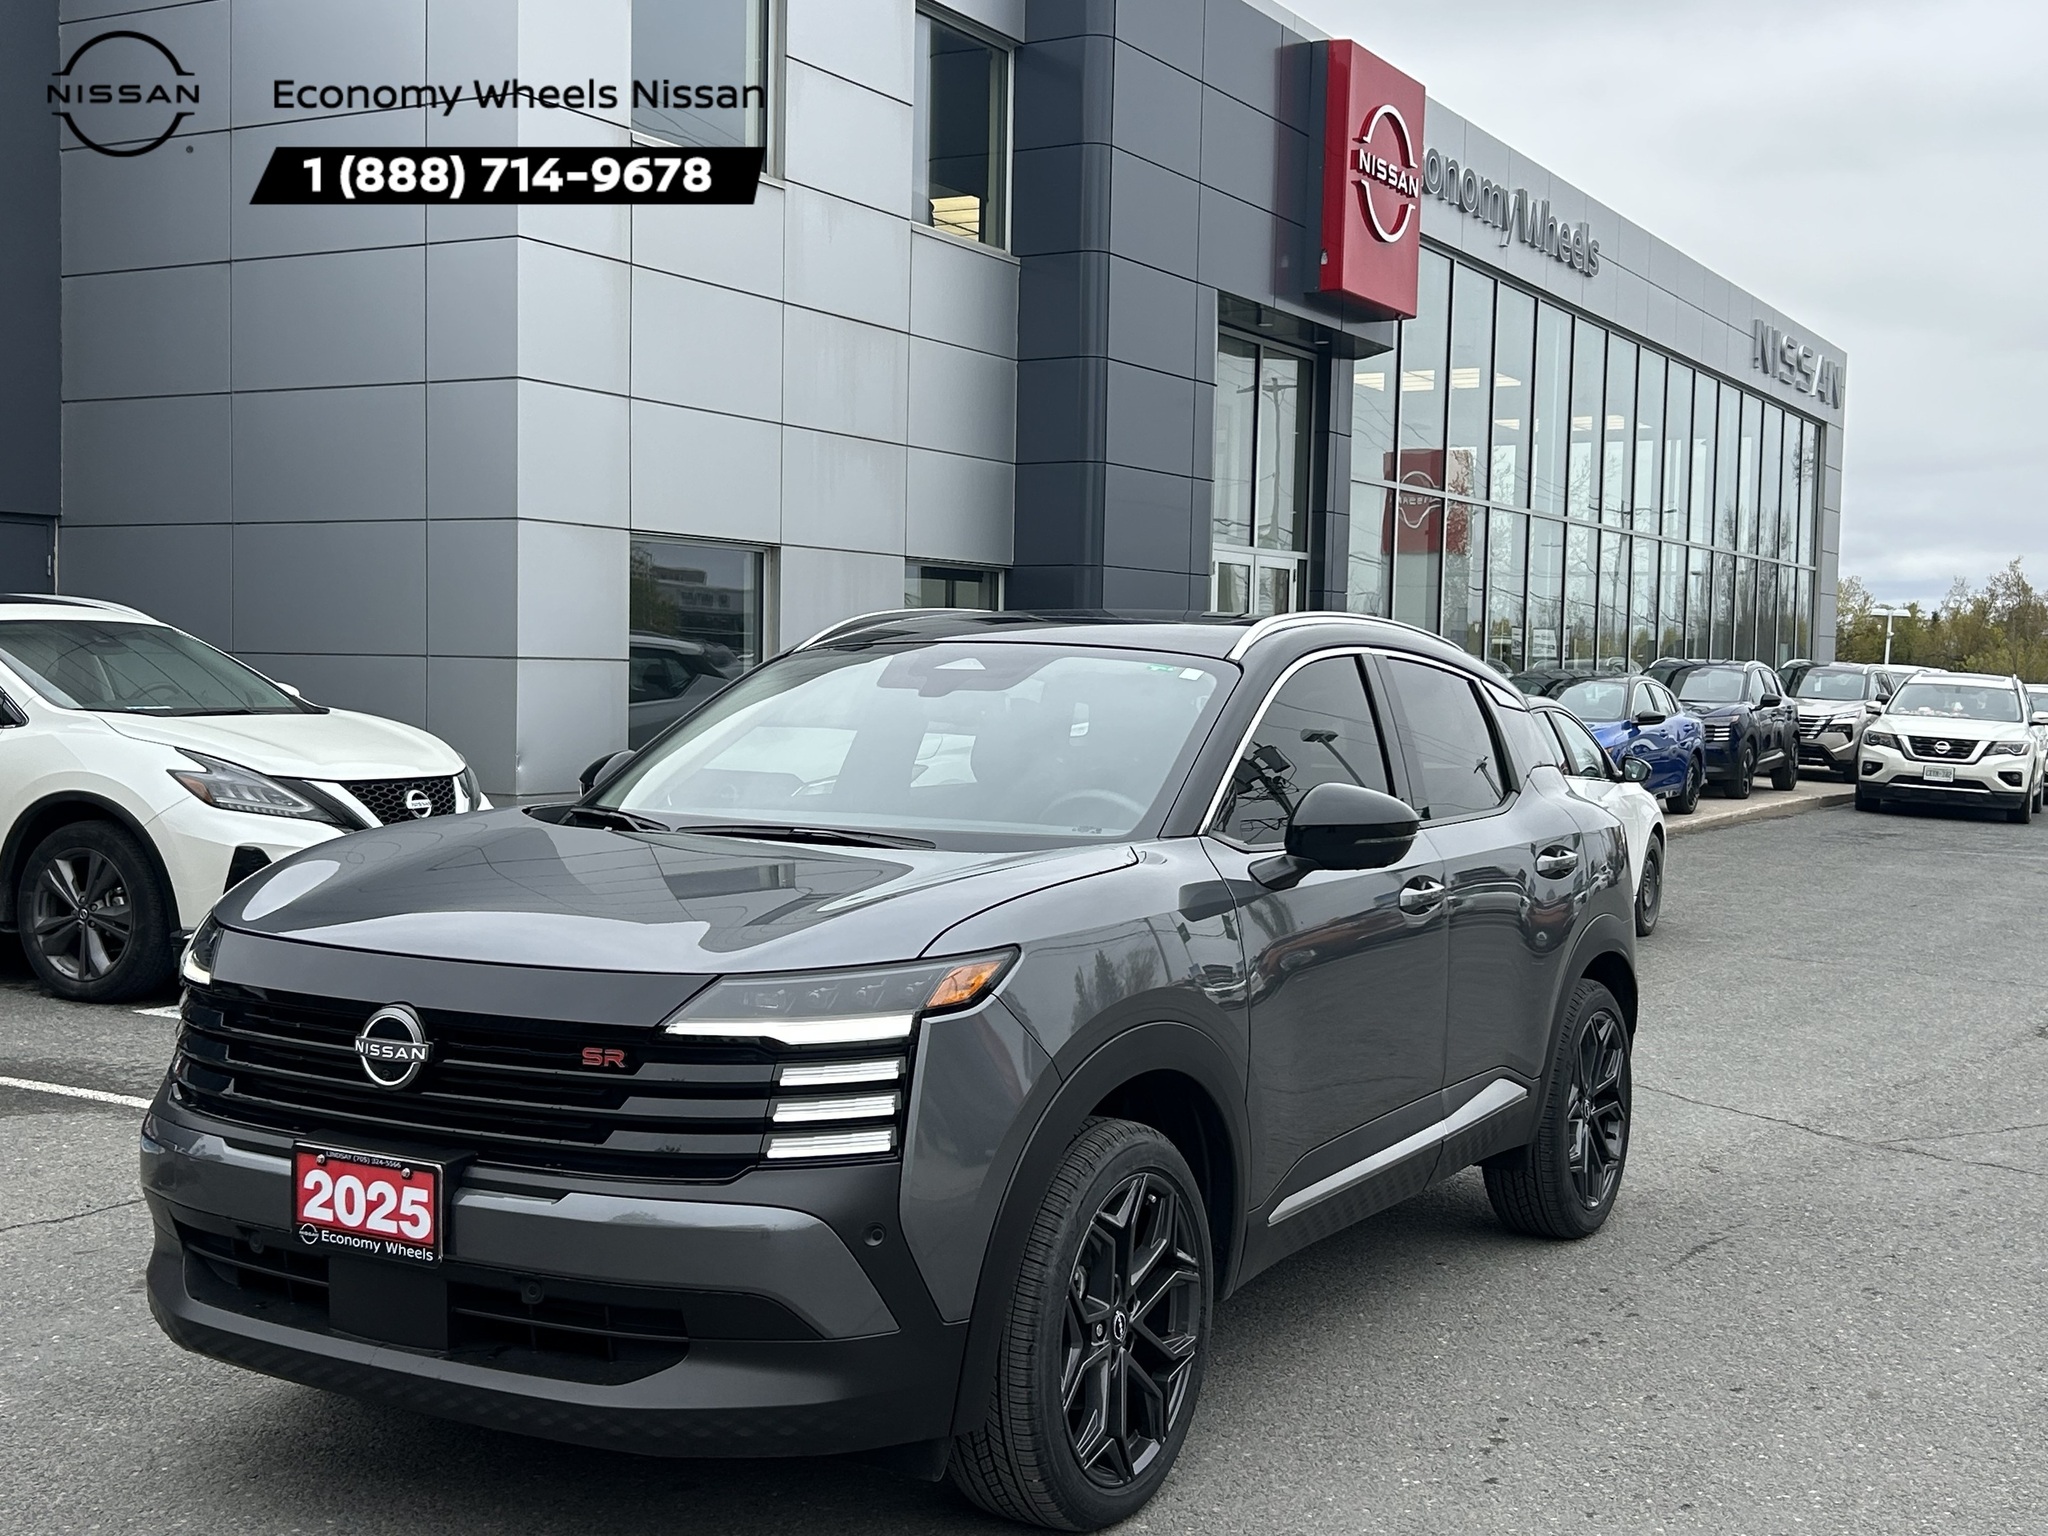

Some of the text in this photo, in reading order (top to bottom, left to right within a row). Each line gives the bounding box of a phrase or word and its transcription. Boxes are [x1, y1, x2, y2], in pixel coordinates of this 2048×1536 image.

[1358, 149, 1419, 199] NISSAN
[1421, 147, 1600, 278] onomy Wheels
[1754, 319, 1844, 409] NISSAN
[354, 1040, 427, 1061] NISSAN
[581, 1046, 626, 1068] SR
[303, 1169, 431, 1240] 2025
[321, 1230, 434, 1262] Economy Wheels
